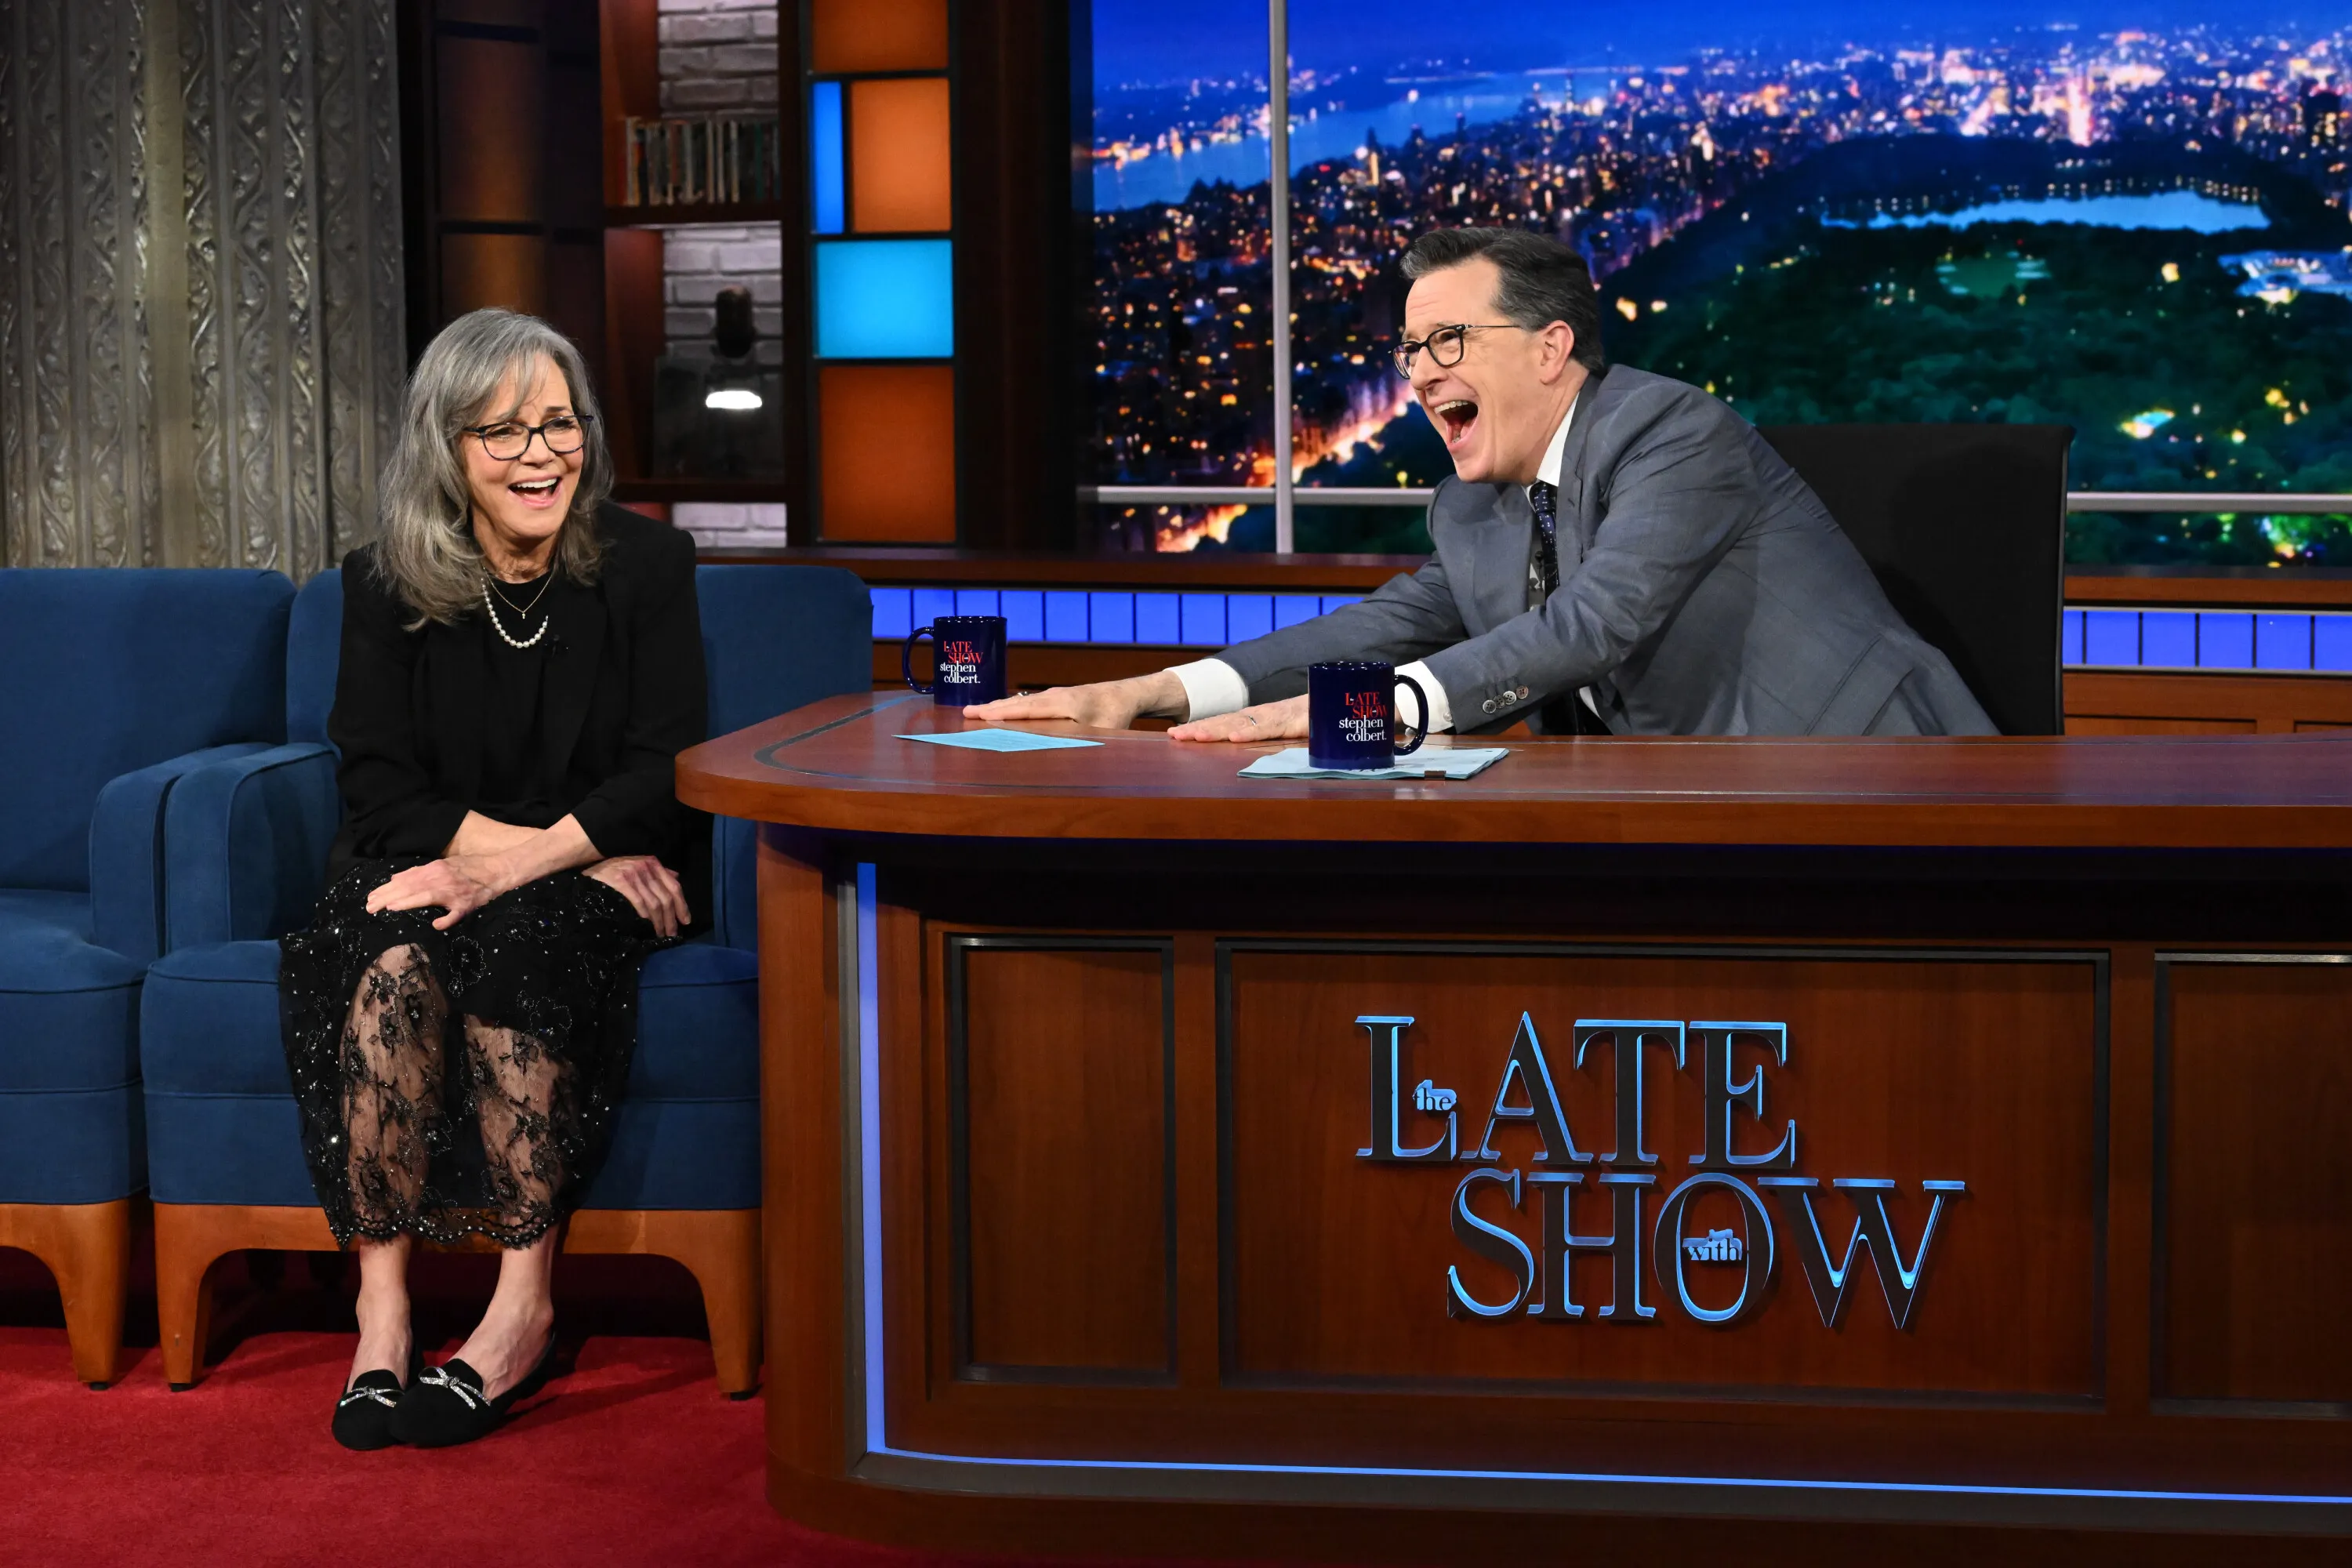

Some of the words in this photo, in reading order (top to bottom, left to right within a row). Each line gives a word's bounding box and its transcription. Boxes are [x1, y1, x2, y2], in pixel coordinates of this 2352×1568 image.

[943, 641, 973, 652] LATE
[948, 652, 984, 664] SHOW
[940, 661, 976, 676] stephen
[944, 672, 981, 684] colbert.
[1345, 691, 1380, 706] LATE
[1352, 705, 1388, 719] SHOW
[1338, 715, 1384, 733] stephen
[1346, 728, 1387, 742] colbert.
[1355, 1011, 1795, 1169] LATE
[1412, 1079, 1457, 1111] the
[1446, 1167, 1965, 1330] SHOW
[1682, 1229, 1743, 1261] with
